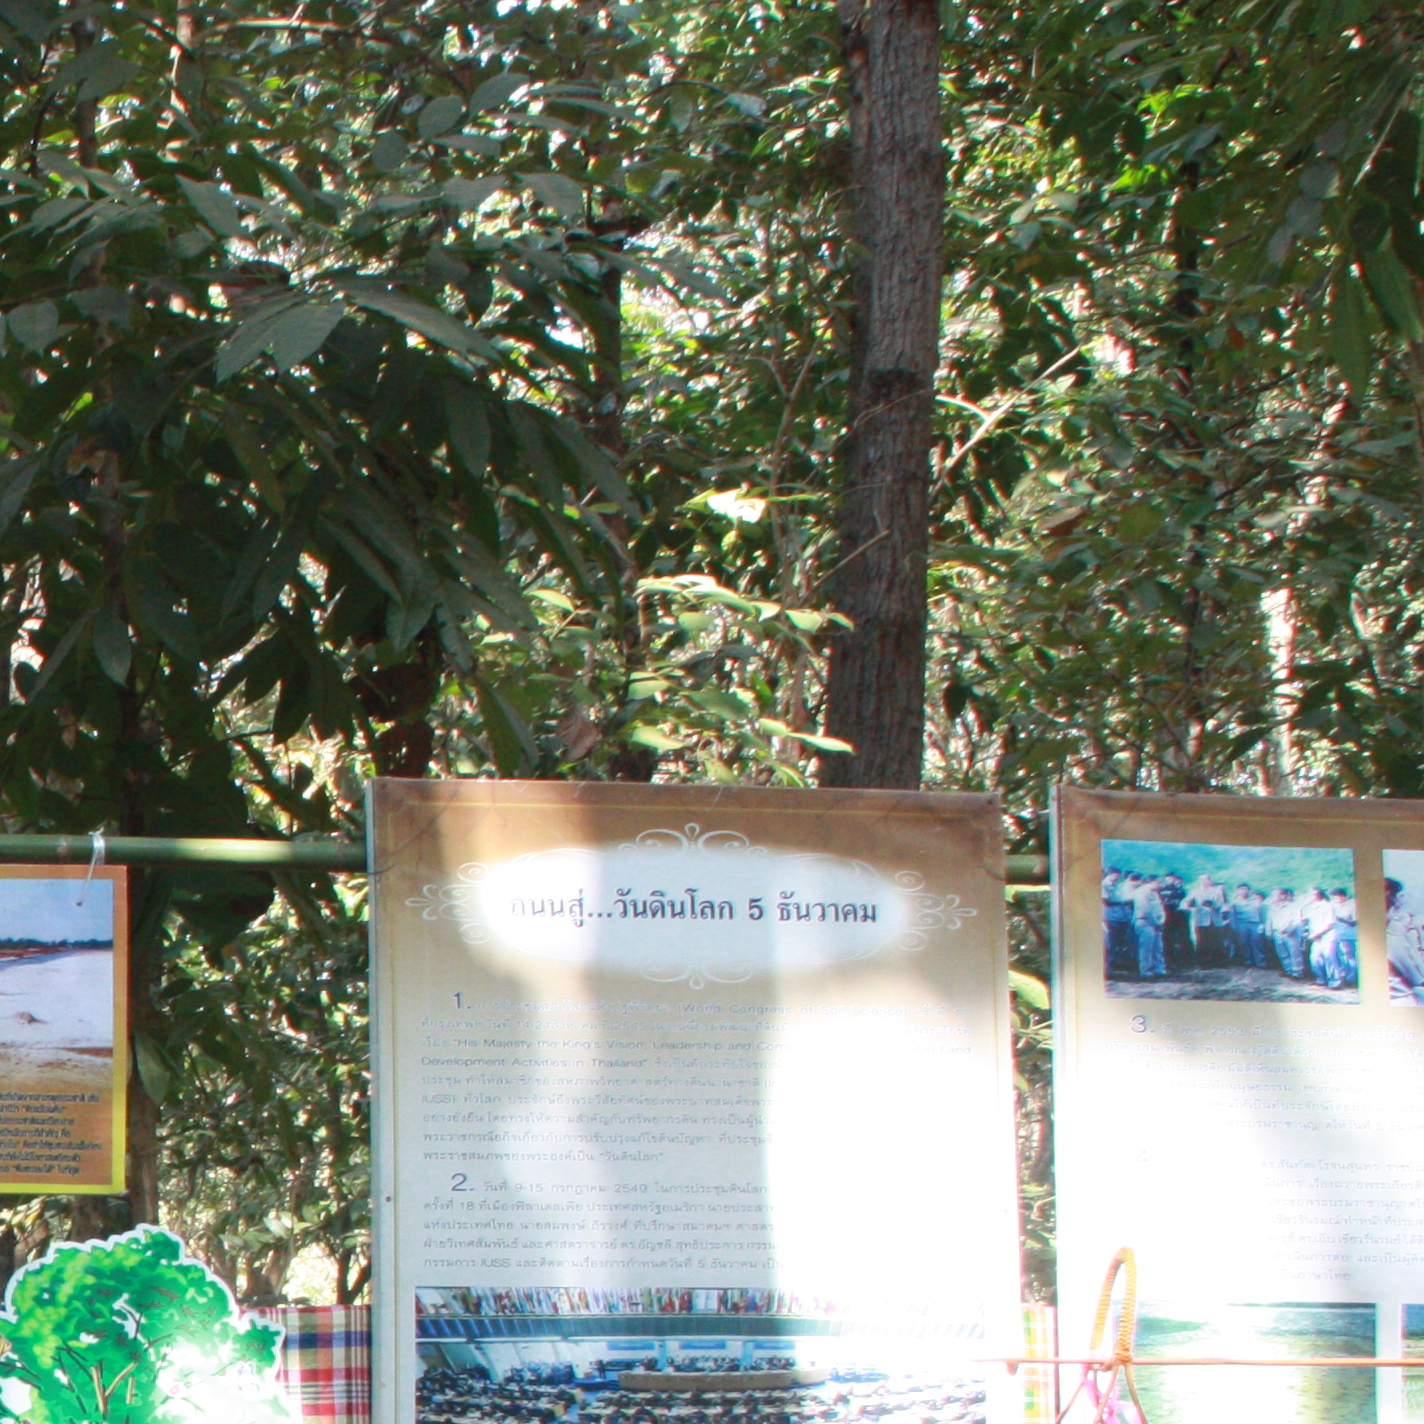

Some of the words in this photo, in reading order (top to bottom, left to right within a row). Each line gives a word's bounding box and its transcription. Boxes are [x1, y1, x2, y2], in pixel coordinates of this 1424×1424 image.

[747, 898, 764, 921] 5
[777, 890, 878, 923] ธันวาคม
[483, 1038, 532, 1050] Majesty
[537, 1039, 560, 1049] the
[652, 1041, 722, 1053] Leadership
[727, 1042, 751, 1051] and
[421, 1056, 505, 1068] Development
[511, 1057, 568, 1068] Activities
[451, 1172, 474, 1192] 2.
[514, 1184, 544, 1194] 9-15
[614, 1183, 648, 1194] 2549
